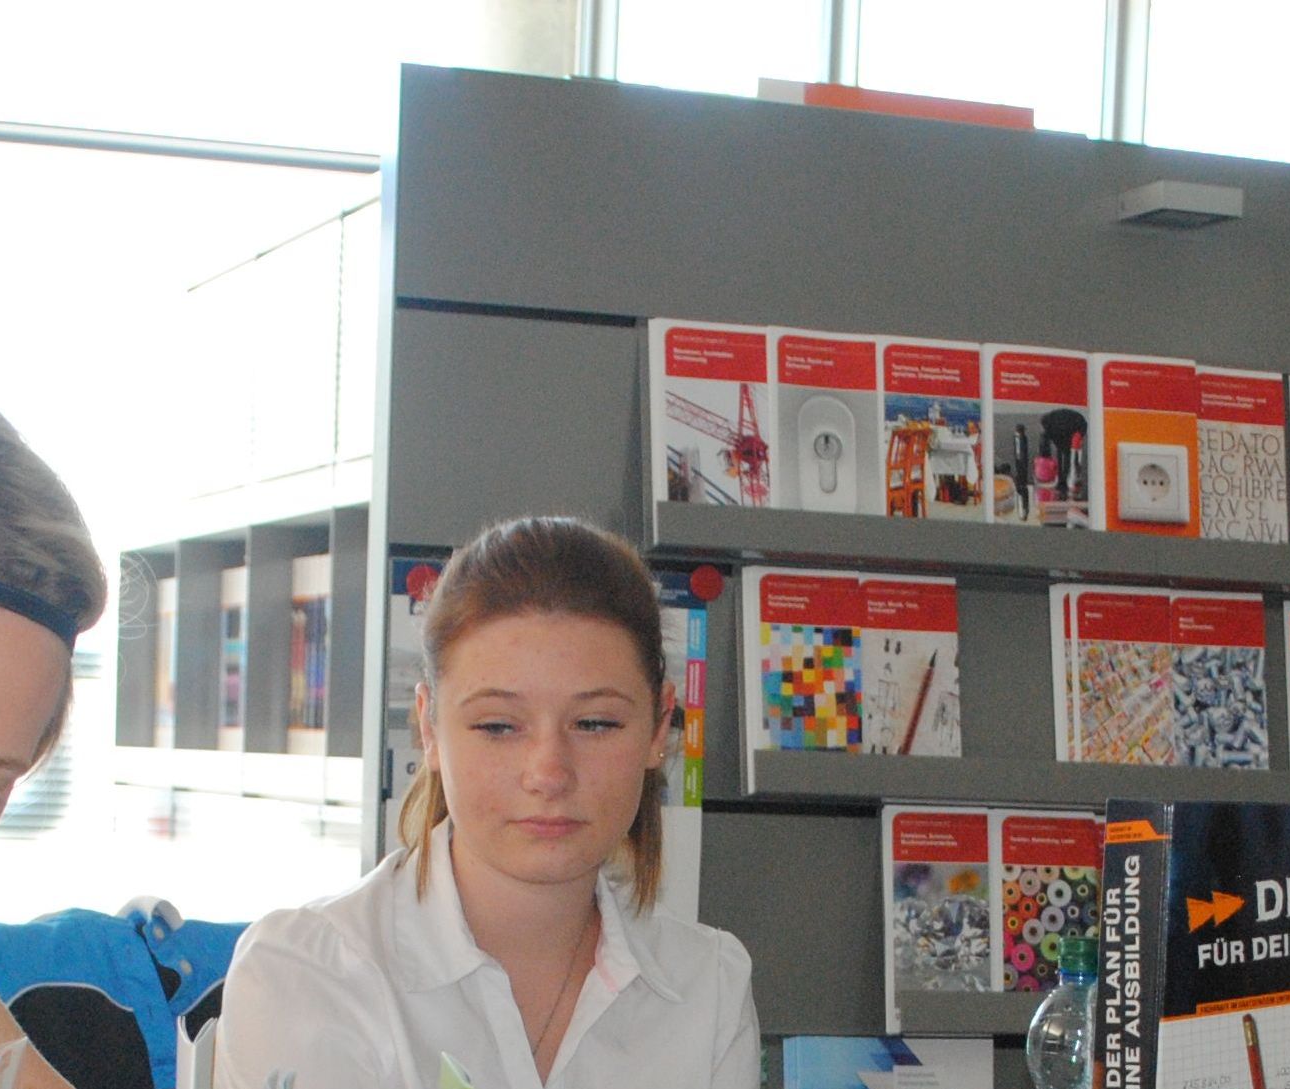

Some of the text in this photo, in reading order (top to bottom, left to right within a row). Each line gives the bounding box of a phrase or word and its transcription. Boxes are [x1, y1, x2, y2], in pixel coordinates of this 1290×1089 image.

[1103, 887, 1122, 1089] DER PLAN FÜR
[1124, 855, 1141, 1038] AUSBILDUNG
[1197, 937, 1246, 969] FÜR
